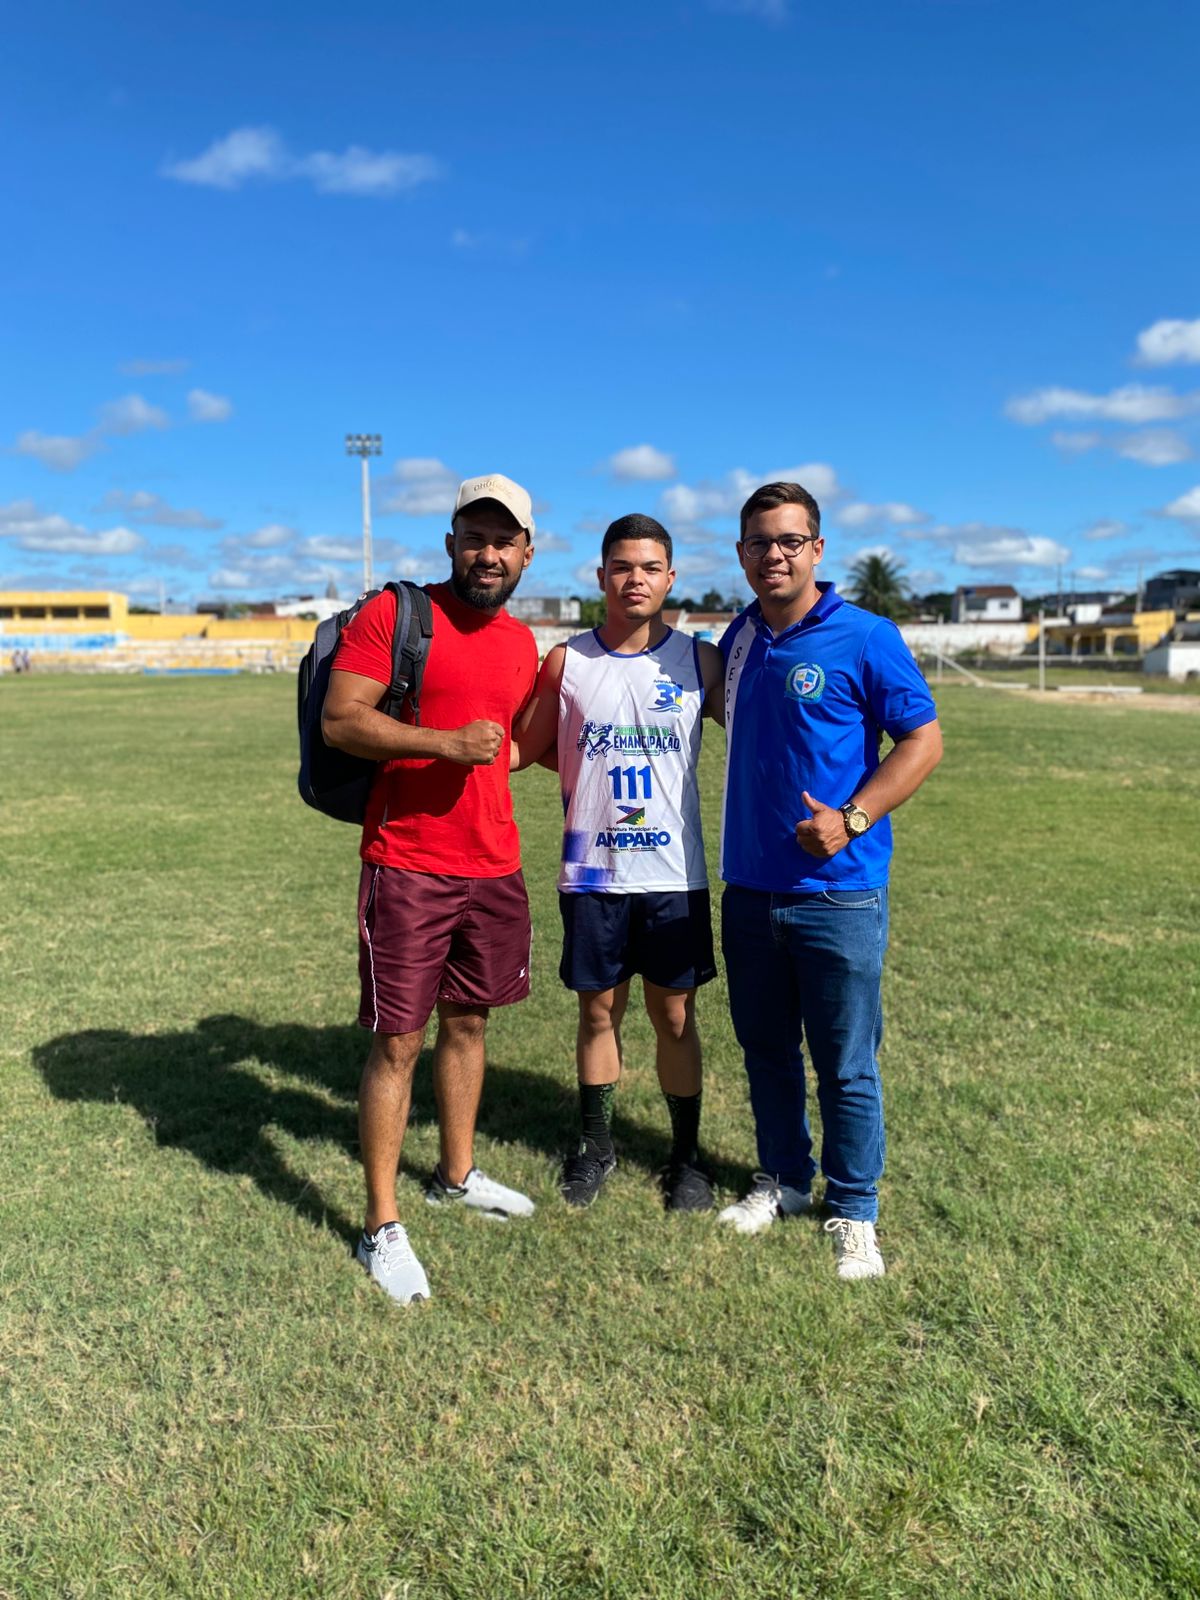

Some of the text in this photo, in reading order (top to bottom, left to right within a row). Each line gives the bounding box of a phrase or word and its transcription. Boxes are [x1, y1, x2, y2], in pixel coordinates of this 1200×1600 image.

[654, 684, 683, 705] 31
[613, 733, 680, 751] EMANCIPAÇÃO
[607, 765, 652, 800] 111
[595, 831, 671, 848] AMPARO
